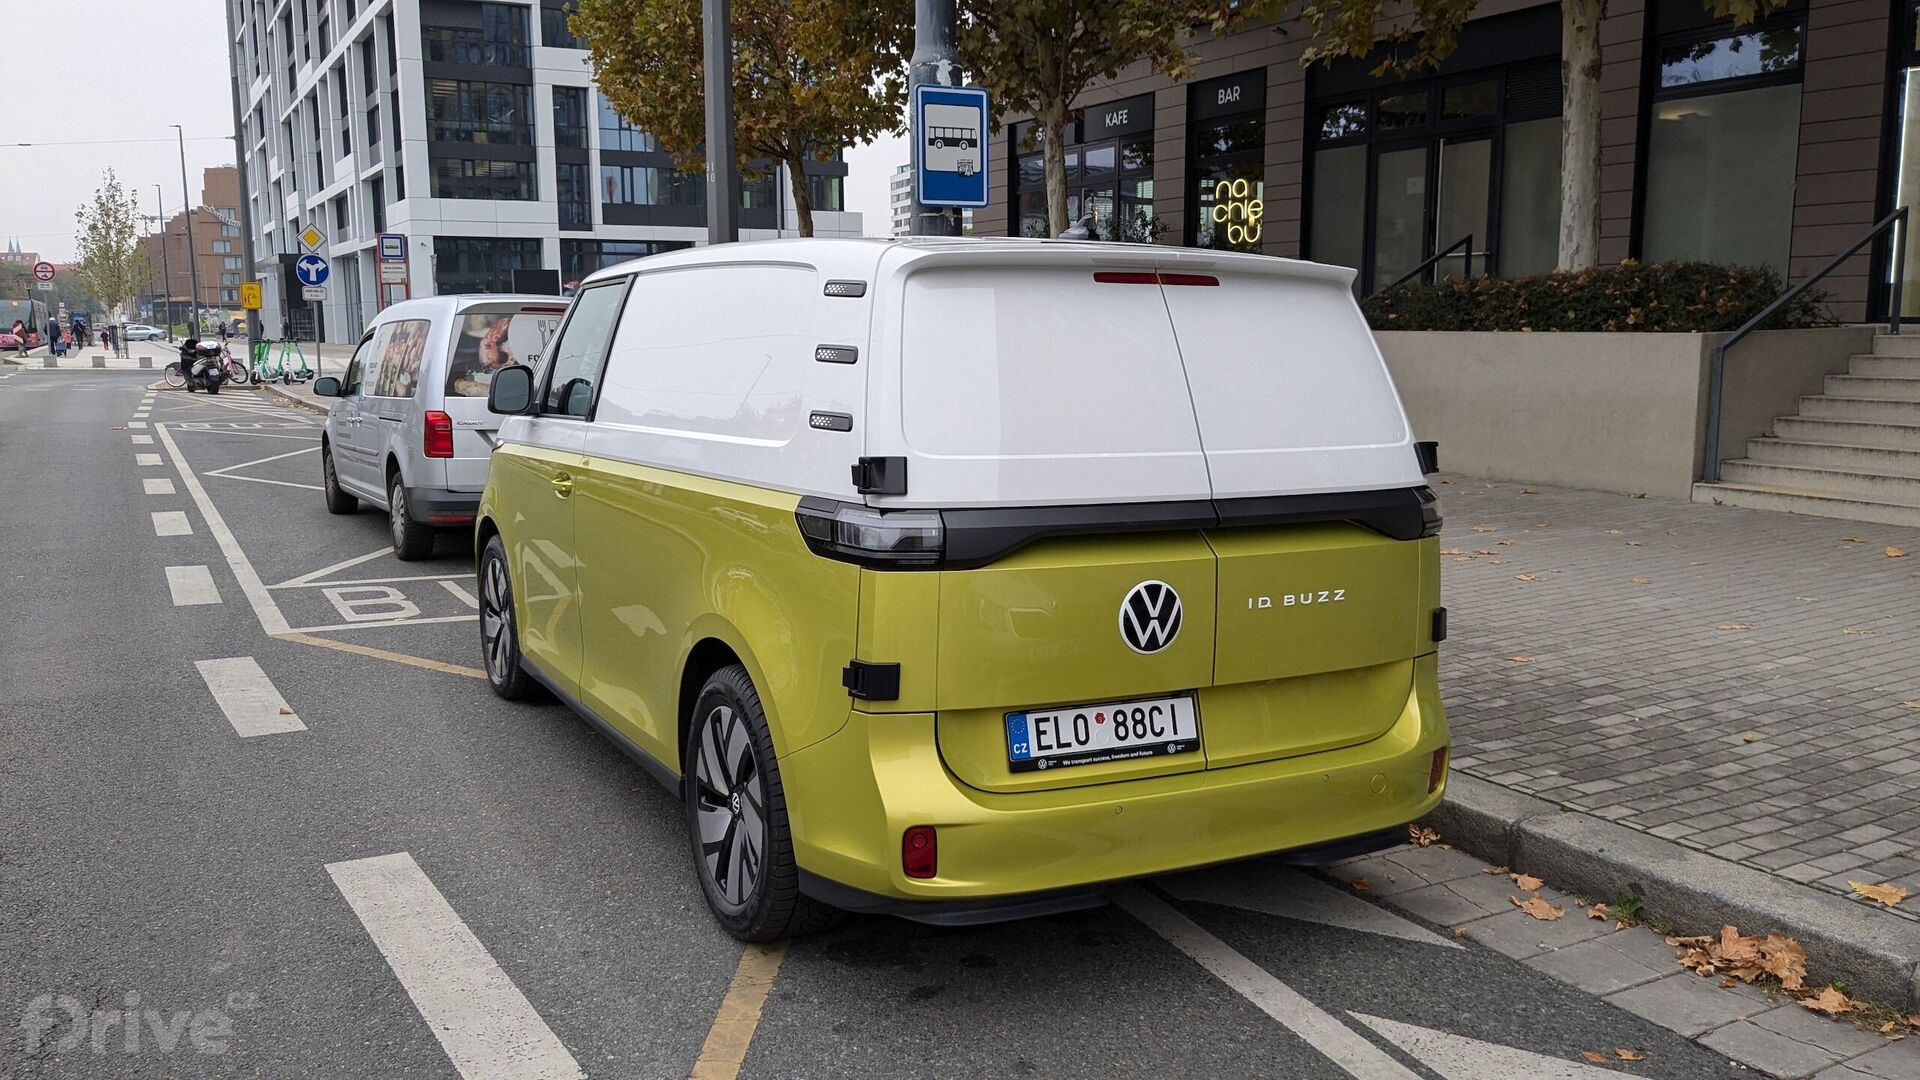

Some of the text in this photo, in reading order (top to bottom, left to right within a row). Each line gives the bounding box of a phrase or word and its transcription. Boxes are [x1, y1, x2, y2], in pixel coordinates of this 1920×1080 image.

[1217, 86, 1240, 105] BAR
[1105, 109, 1129, 128] KAFE
[1216, 178, 1248, 199] na
[1213, 199, 1263, 223] chle
[1283, 589, 1345, 607] BUZZ
[1013, 743, 1028, 755] CZ
[1071, 757, 1093, 767] transport
[1093, 754, 1111, 763] success,
[1111, 752, 1130, 760] freedom
